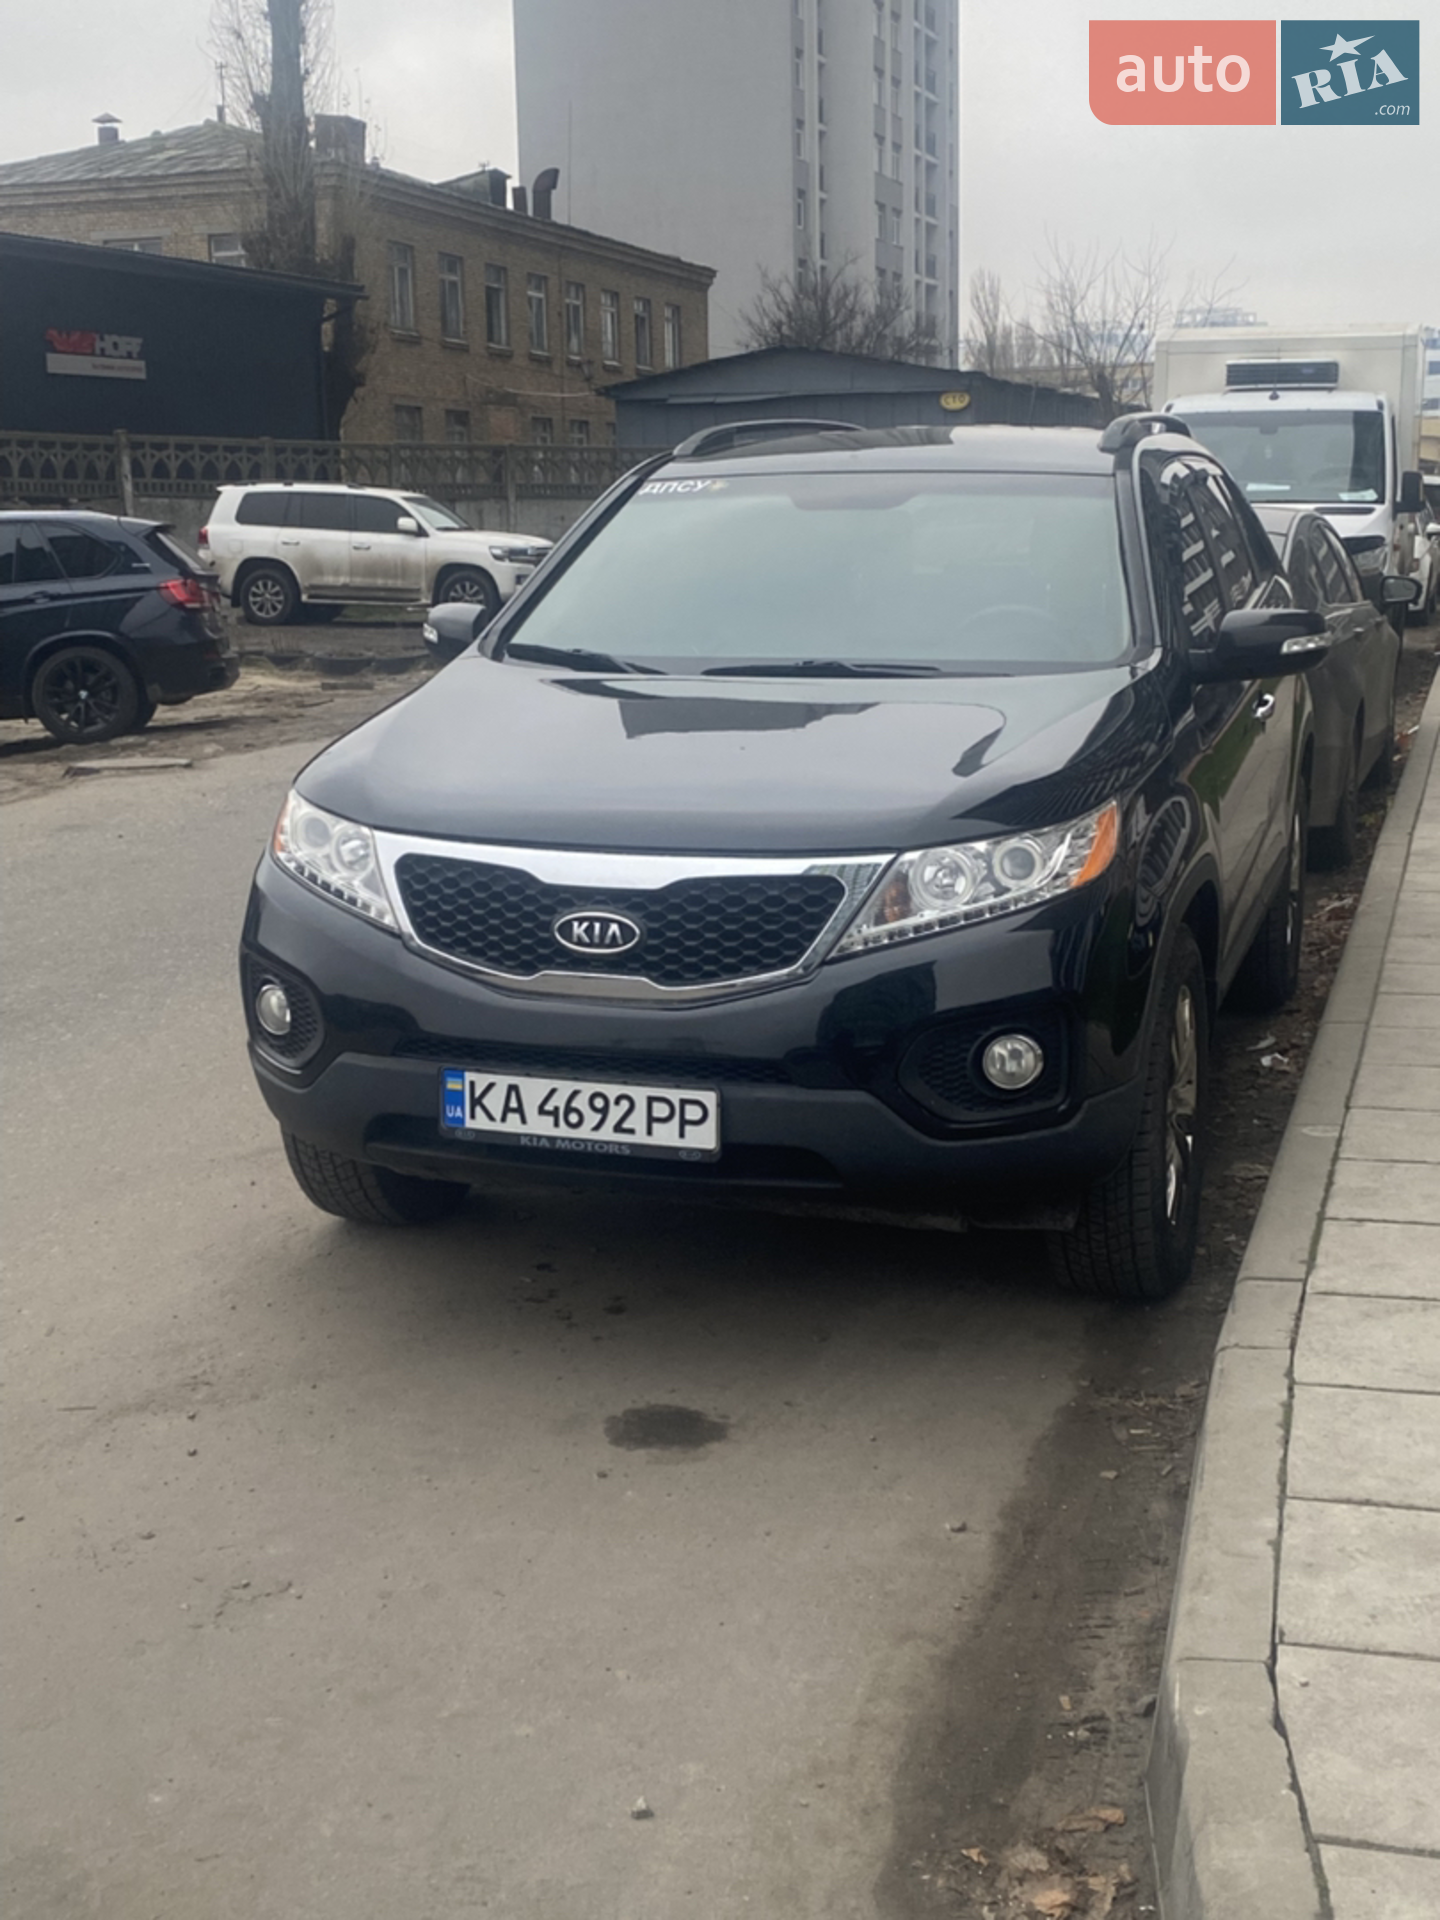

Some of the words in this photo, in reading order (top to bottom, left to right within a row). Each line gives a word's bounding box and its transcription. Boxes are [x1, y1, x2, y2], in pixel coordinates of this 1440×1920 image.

[571, 920, 623, 945] KIA
[446, 1104, 463, 1118] UA
[469, 1080, 527, 1125] KA
[537, 1087, 636, 1135] 4692
[646, 1095, 709, 1139] PP
[520, 1135, 550, 1147] KIA
[555, 1139, 631, 1155] MOTORS
